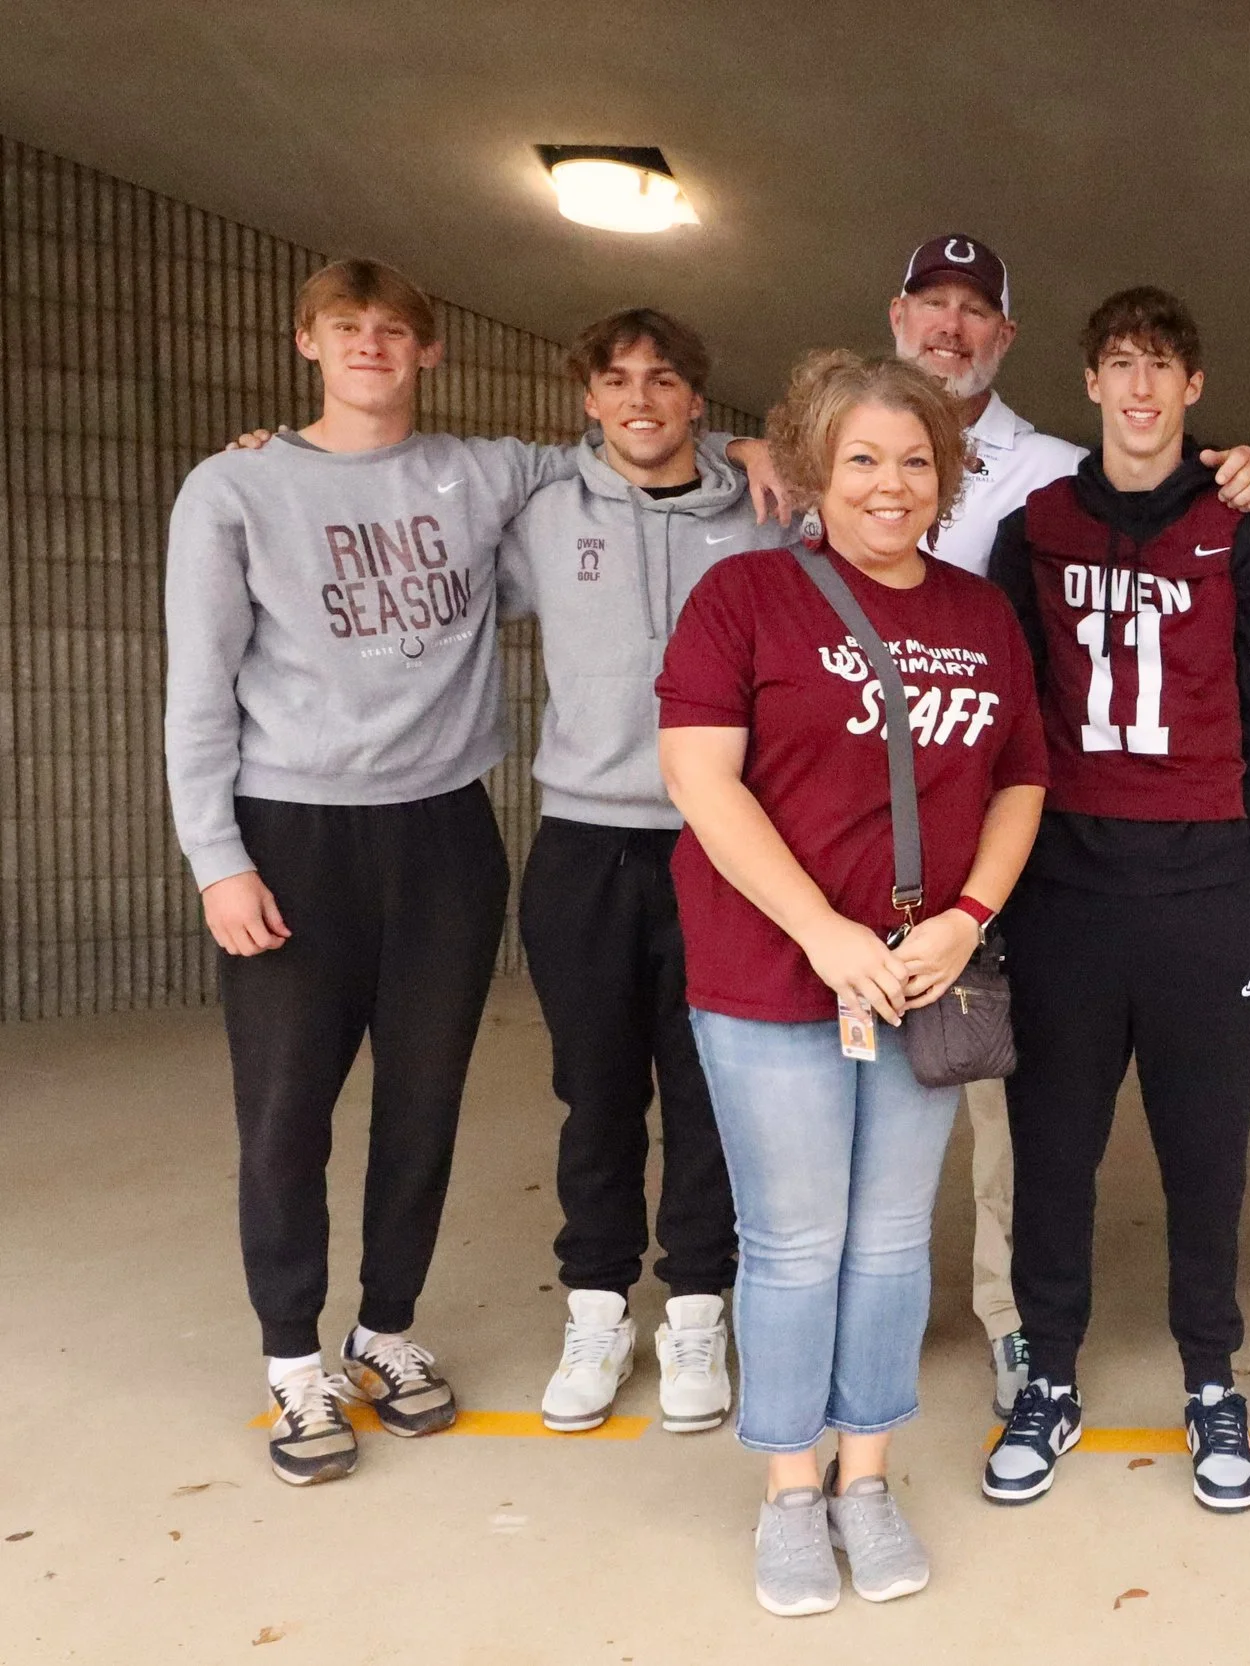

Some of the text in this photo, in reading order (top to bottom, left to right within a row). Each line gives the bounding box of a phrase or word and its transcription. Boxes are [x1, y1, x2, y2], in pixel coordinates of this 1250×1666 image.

[325, 515, 448, 580] RING
[577, 538, 605, 551] OWEN
[577, 571, 600, 581] GOLF
[1064, 564, 1192, 615] OWEN
[322, 568, 471, 638] SEASON
[868, 657, 976, 677] IMARY
[1076, 611, 1170, 755] 11
